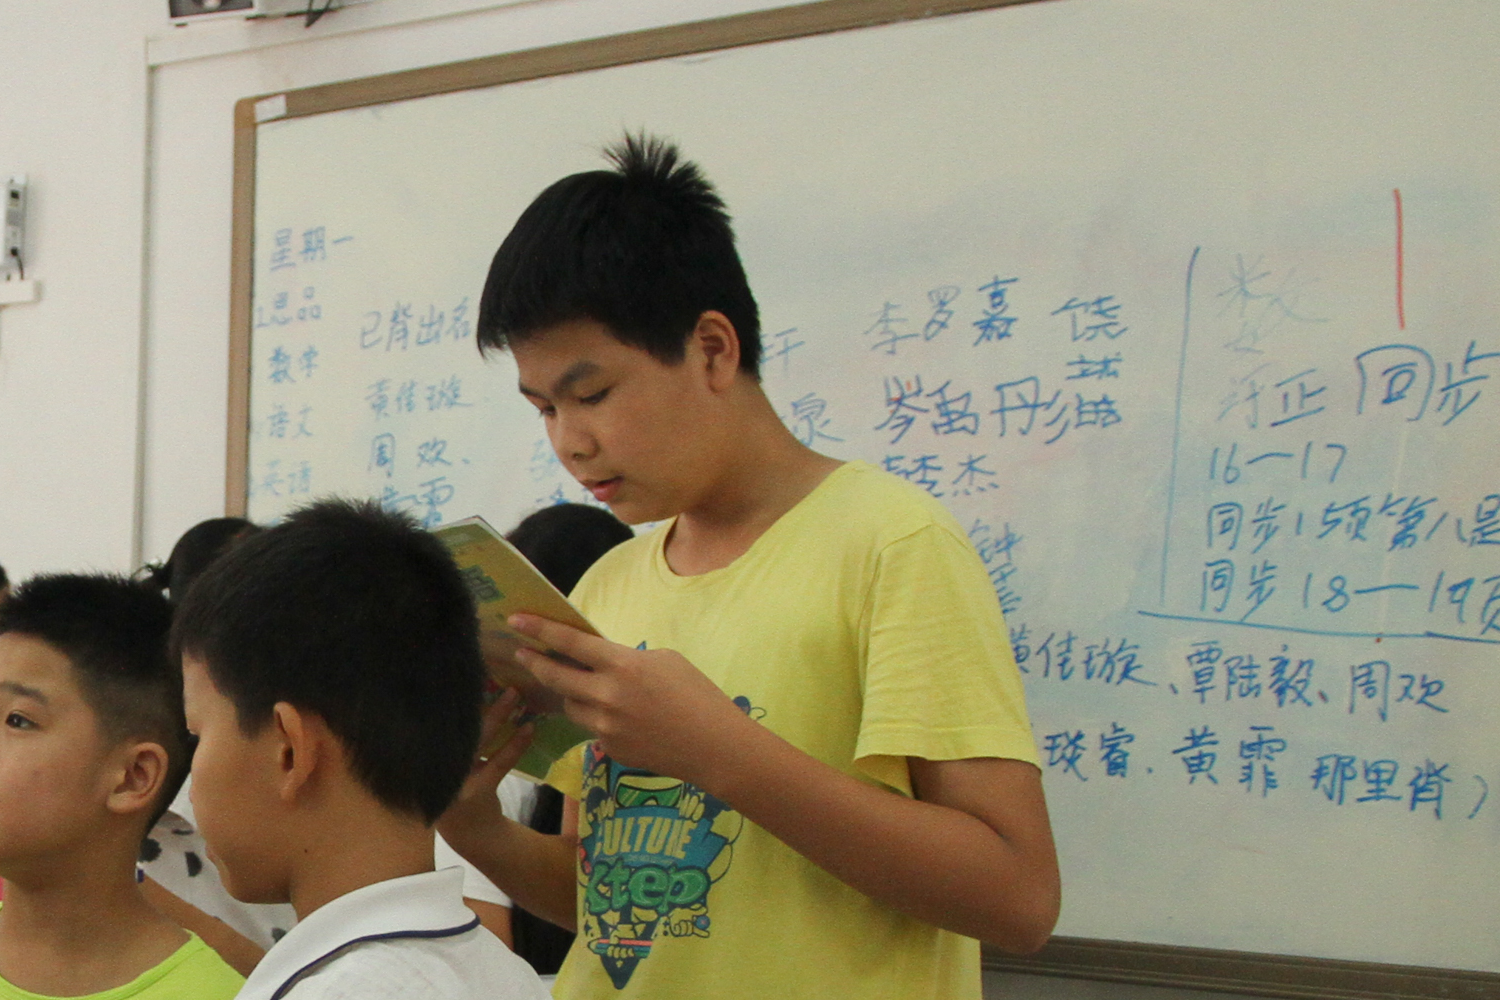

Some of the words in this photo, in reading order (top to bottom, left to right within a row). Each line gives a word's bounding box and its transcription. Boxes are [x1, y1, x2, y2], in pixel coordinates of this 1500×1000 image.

[269, 227, 355, 272] 星期一
[267, 346, 319, 383] 数学
